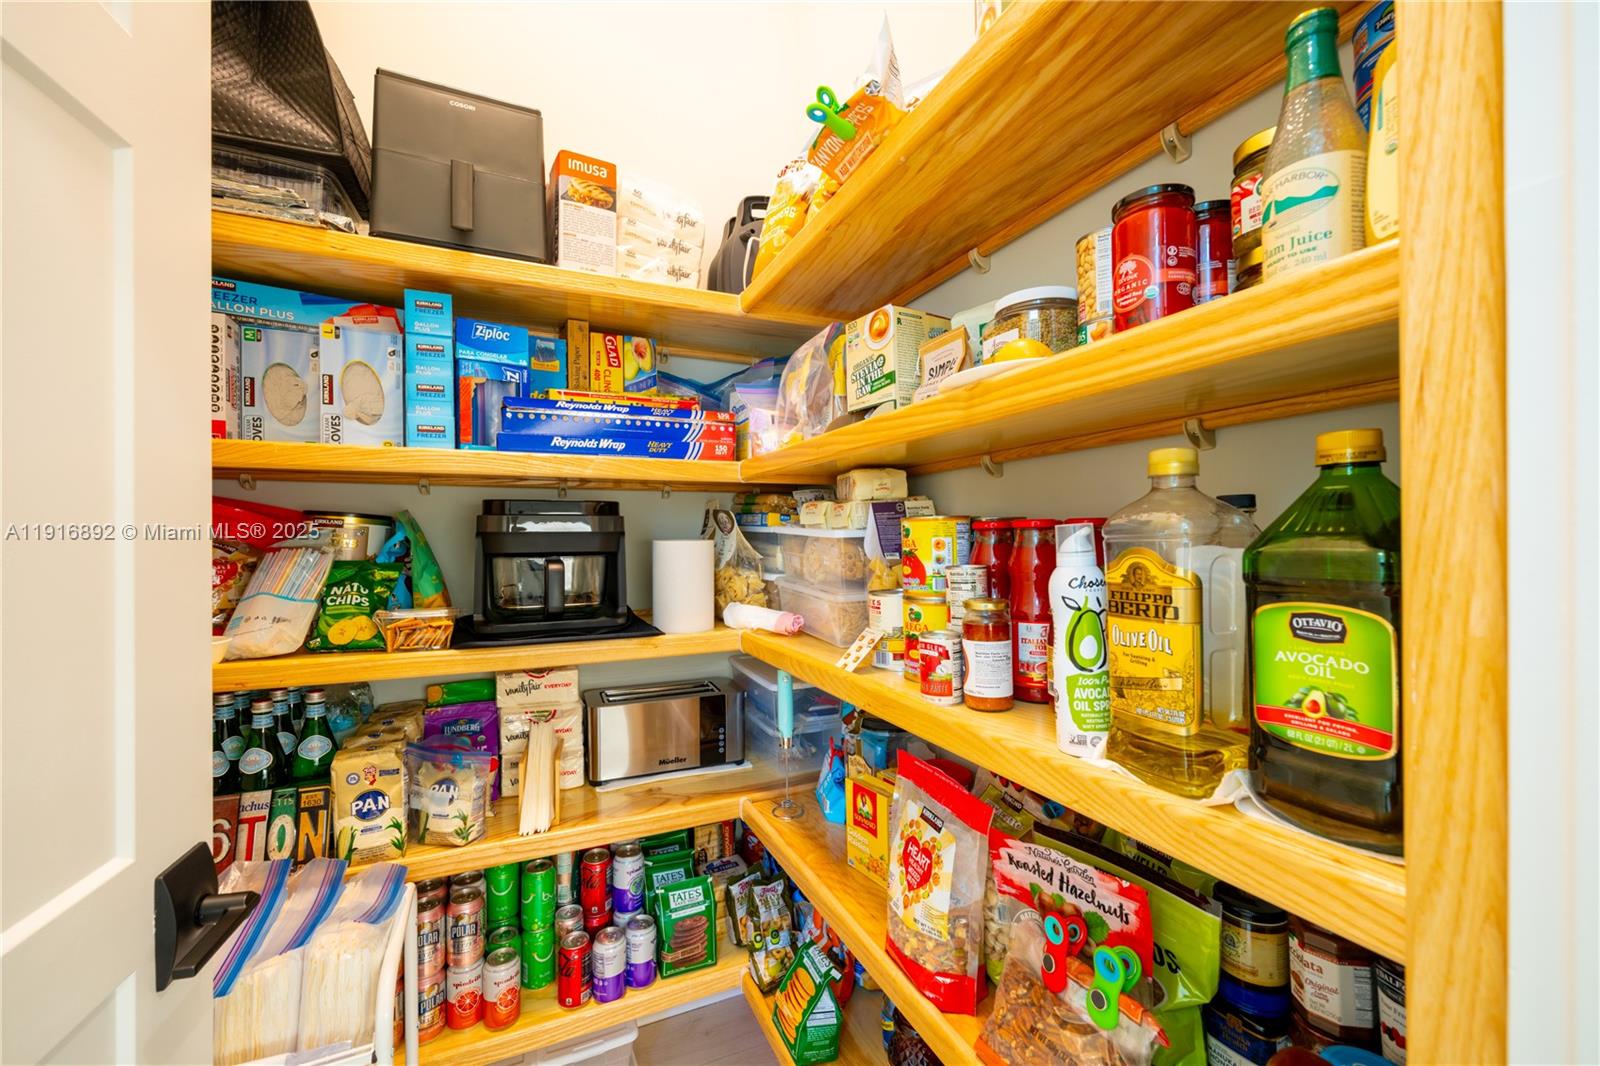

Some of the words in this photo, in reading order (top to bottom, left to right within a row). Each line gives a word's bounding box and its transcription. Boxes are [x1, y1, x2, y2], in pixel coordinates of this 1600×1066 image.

[449, 100, 476, 111] COSORI
[1289, 228, 1333, 252] Juice
[414, 308, 445, 316] FREEZER
[415, 301, 443, 309] KIRKLAND
[259, 307, 295, 321] PLUS
[414, 321, 440, 329] GALLON
[475, 324, 510, 342] Ziploc
[605, 335, 621, 367] GLAD
[851, 361, 878, 384] STEVIA
[416, 391, 446, 399] FREEZER
[856, 383, 871, 399] RAW
[555, 400, 603, 412] Reynolds
[603, 404, 630, 414] Wrap
[330, 415, 341, 441] OVES
[551, 436, 598, 449] Reynolds
[599, 439, 626, 452] Wrap
[647, 440, 673, 449] HEAVY
[326, 594, 370, 607] CHIPS
[1111, 591, 1173, 605] FILIPPO
[1108, 601, 1179, 621] BERIO
[1292, 617, 1343, 633] OTTAVIO
[1112, 624, 1147, 649] OLIVE
[1147, 628, 1173, 656] OIL
[1275, 650, 1370, 675] AVOCADO
[1304, 664, 1336, 680] OIL
[543, 681, 573, 690] EVERYDAY
[1073, 699, 1092, 712] OIL
[302, 798, 322, 807] 1630
[923, 809, 943, 828] KIRKLAND
[907, 842, 930, 869] HEART
[654, 869, 684, 883] TATE'S
[1062, 858, 1097, 888] Garden
[670, 889, 702, 903] TATE'S
[1006, 852, 1054, 886] Roasted
[1058, 872, 1130, 926] Hazelnuts
[451, 923, 477, 939] POLAR
[1305, 976, 1339, 995] Original
[420, 990, 445, 1014] POLAR
